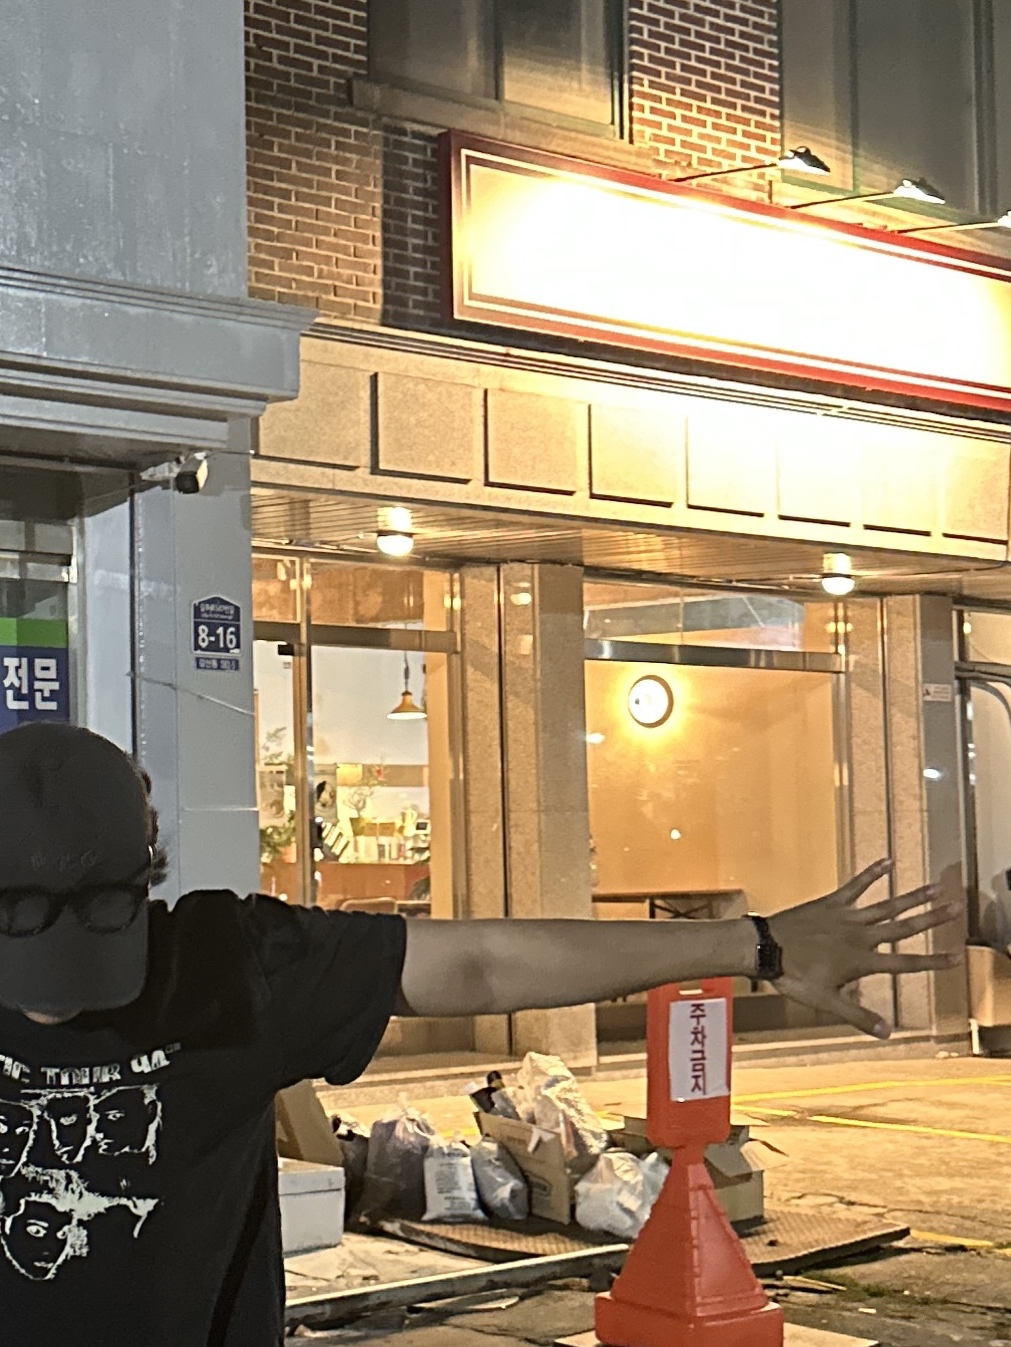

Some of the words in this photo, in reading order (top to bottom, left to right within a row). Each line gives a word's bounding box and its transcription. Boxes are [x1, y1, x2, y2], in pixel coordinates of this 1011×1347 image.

[197, 624, 237, 649] 8-16
[2, 657, 60, 711] 전문
[690, 1003, 707, 1095] 주차금지
